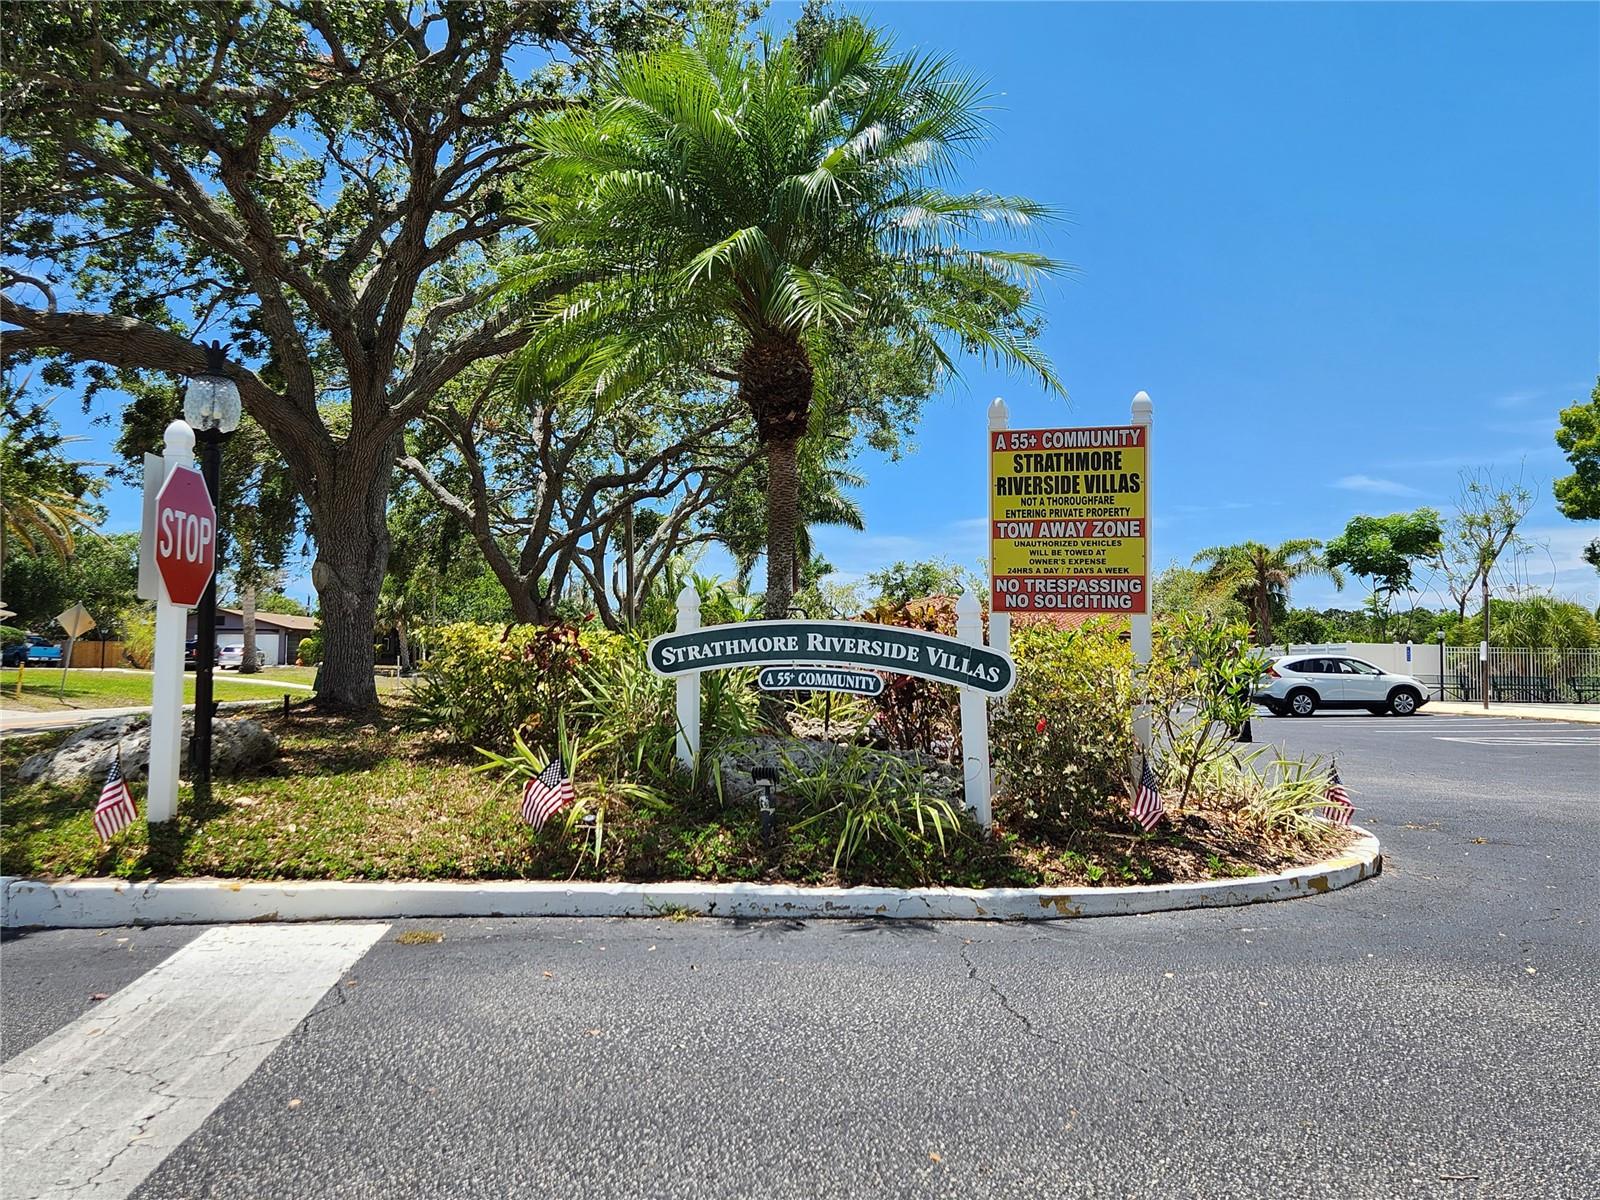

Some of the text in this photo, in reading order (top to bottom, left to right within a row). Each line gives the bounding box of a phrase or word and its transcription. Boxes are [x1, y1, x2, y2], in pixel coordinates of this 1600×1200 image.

[995, 429, 1141, 450] A 55+ COMMUNITY
[1013, 451, 1122, 473] STRATHMORE
[997, 473, 1140, 496] RIVERSIDE VILLAS
[1020, 495, 1115, 507] NOT A THOROUGHFARE
[1005, 507, 1131, 519] ENTERING PRIVATE PROPERTY
[160, 507, 212, 564] STOP
[996, 520, 1141, 539] TOW AWAY ZONE
[1014, 539, 1122, 548] UNAUTHORIZED VEHICLES
[1007, 567, 1034, 575] 24HRS
[996, 578, 1142, 593] NO TRESPASSING
[1005, 594, 1132, 609] NO SOLICITING
[661, 633, 1001, 683] STRATHMORE RIVERSIDE VILLAS
[765, 672, 877, 690] A 55+ COMMUNITY
